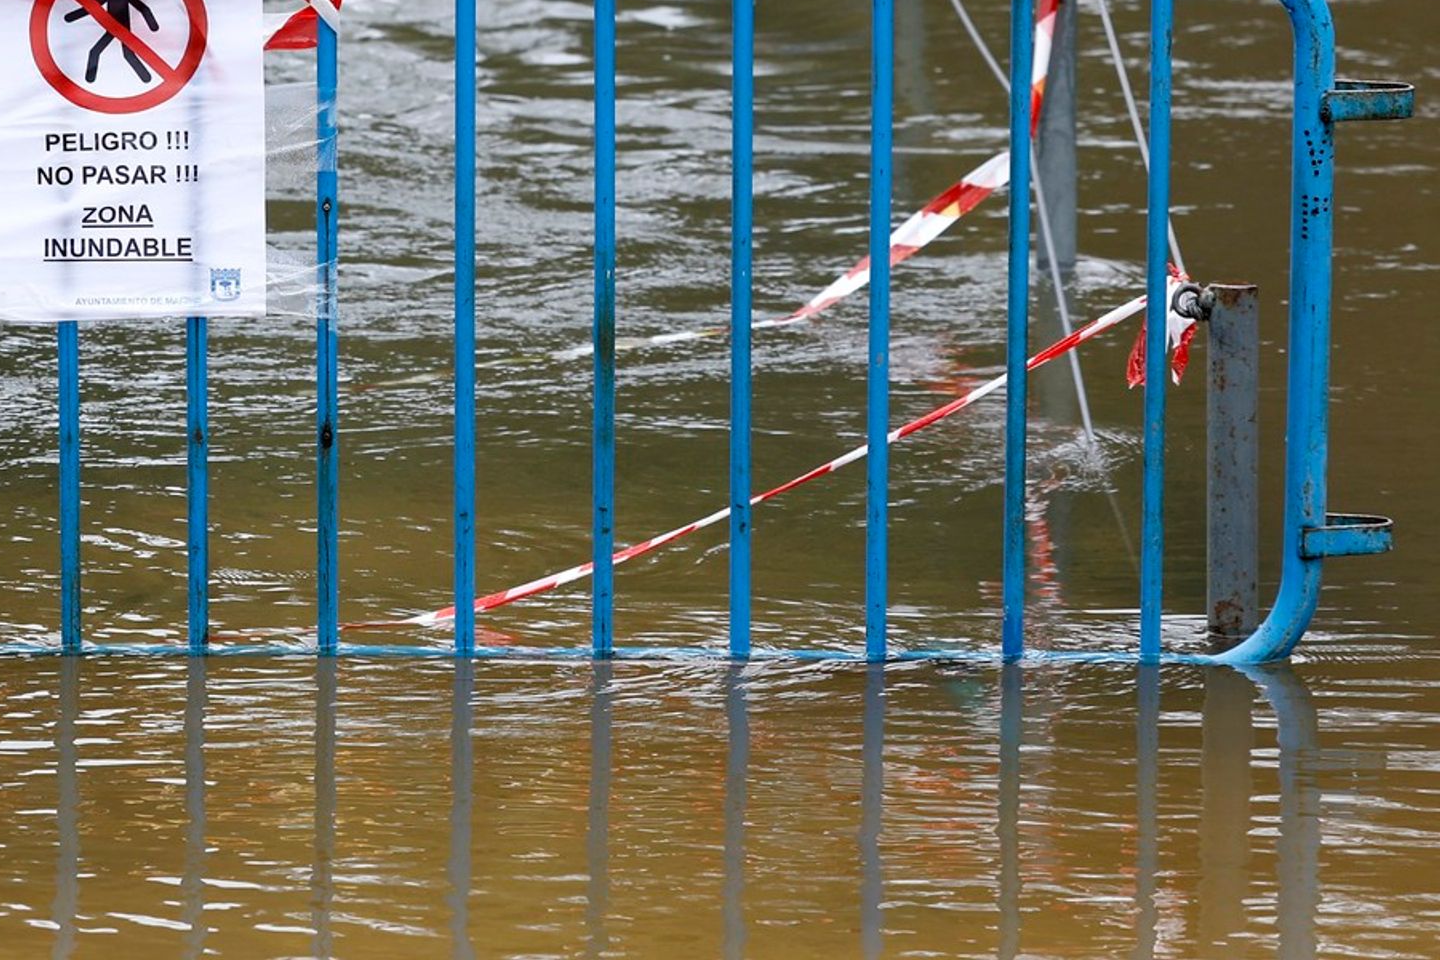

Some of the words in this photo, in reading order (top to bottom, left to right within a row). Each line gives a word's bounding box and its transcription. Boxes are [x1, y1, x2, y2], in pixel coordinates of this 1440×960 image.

[45, 131, 158, 151] PELIGRO
[166, 130, 189, 149] !!!
[37, 166, 74, 185] NO
[83, 165, 167, 184] PASAR
[176, 164, 198, 182] !!!
[81, 204, 153, 224] ZONA
[44, 237, 192, 258] INUNDABLE
[75, 297, 148, 306] AYUNTAMIENTO
